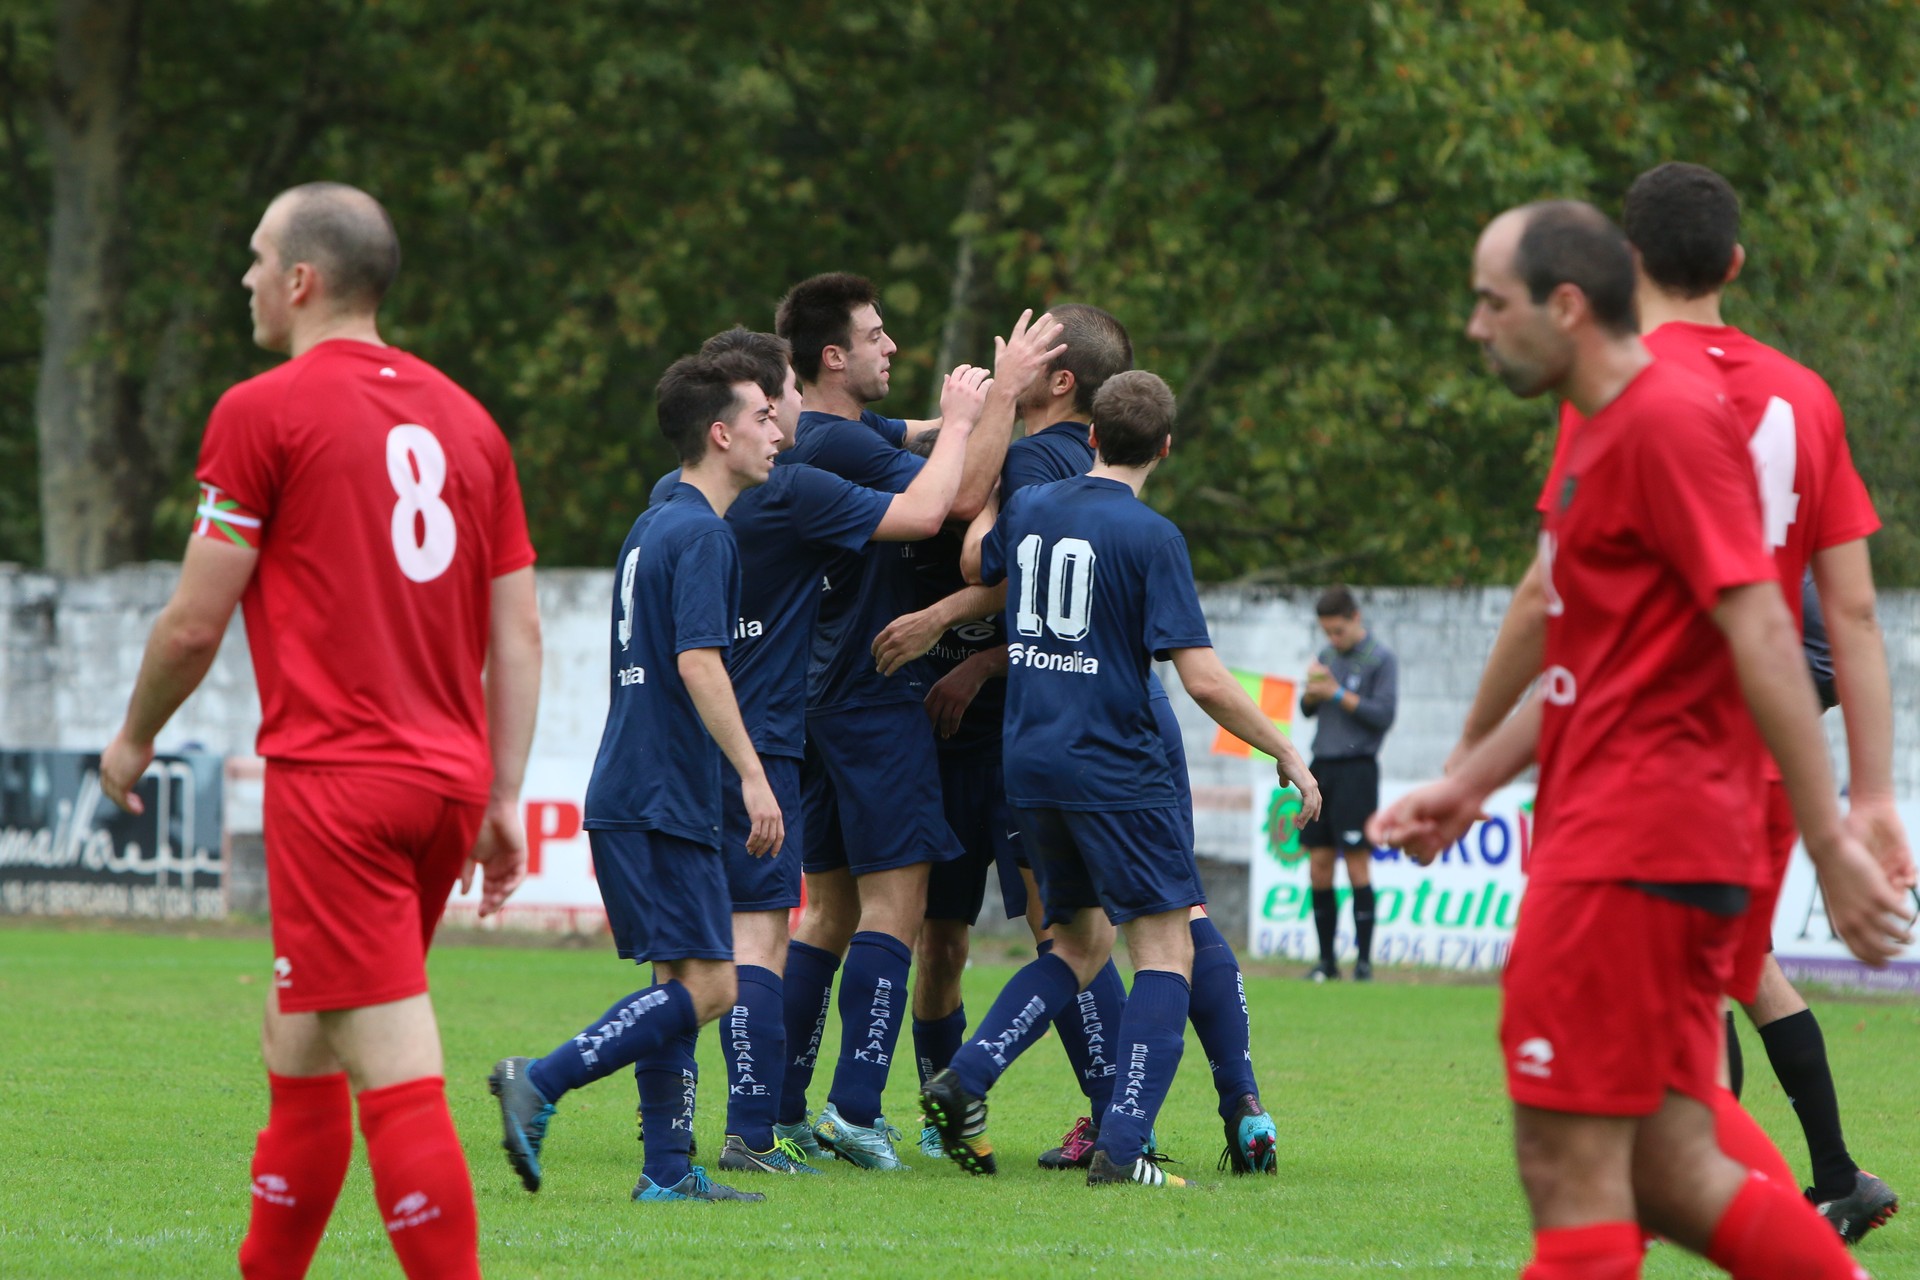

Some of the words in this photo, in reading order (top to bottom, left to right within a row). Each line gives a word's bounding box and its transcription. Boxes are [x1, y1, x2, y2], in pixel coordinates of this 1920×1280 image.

[386, 423, 457, 583] 8
[1016, 533, 1097, 642] 10
[1025, 645, 1099, 675] fonalia
[730, 1005, 756, 1084] BERGARA
[866, 977, 892, 1051] BERGARA
[1076, 990, 1107, 1067] BERGARA
[1123, 1043, 1149, 1109] BERGARA
